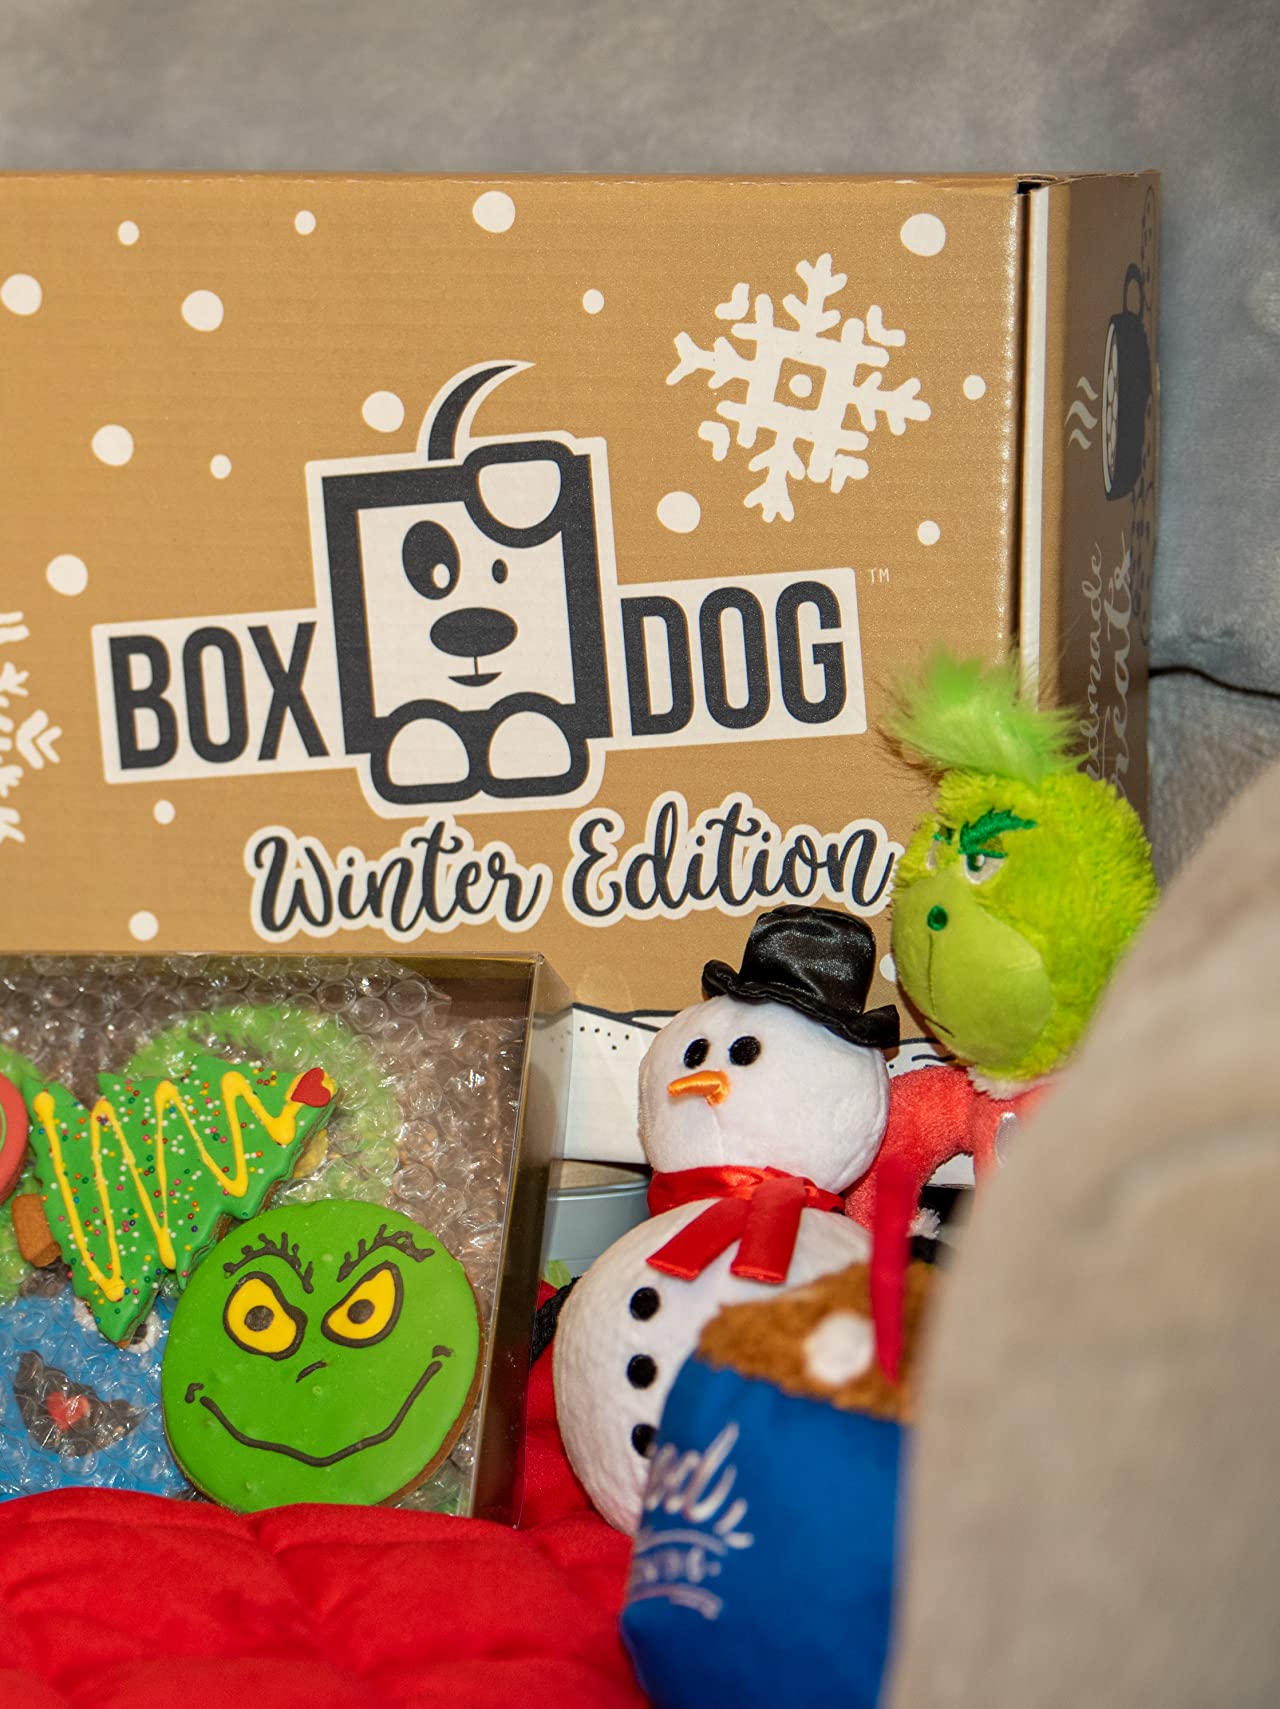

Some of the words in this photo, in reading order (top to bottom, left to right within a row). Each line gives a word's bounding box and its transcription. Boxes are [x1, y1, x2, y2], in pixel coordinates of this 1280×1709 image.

[108, 621, 330, 771] BOX
[619, 580, 847, 738] DOG
[868, 567, 890, 584] TM
[253, 820, 543, 933] Winter
[571, 800, 896, 918] Edition
